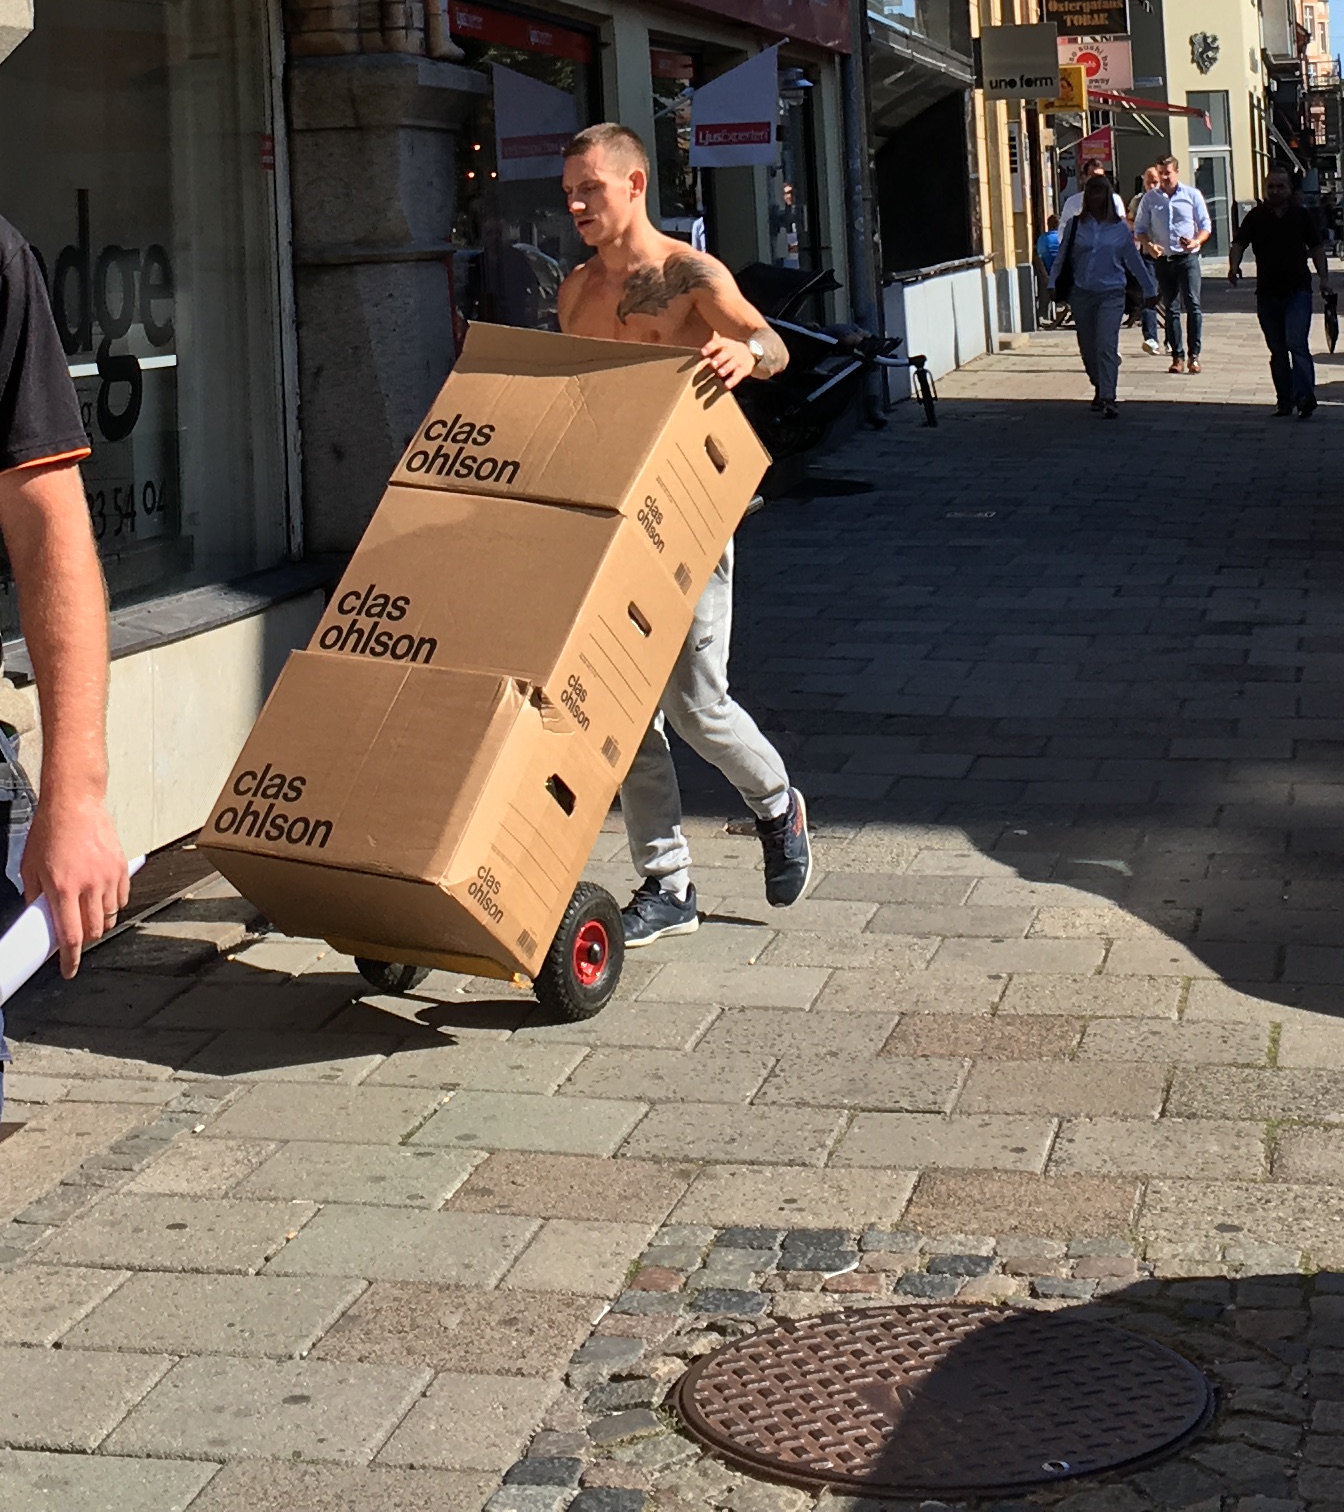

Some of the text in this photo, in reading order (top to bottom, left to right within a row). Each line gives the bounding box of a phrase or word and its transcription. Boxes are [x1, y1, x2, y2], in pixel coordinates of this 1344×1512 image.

[1063, 13, 1109, 27] TOBAK
[989, 74, 1054, 90] uno form
[31, 189, 177, 441] dge
[423, 413, 496, 448] clas
[405, 446, 522, 485] ohlson
[644, 494, 664, 526] clas
[637, 508, 666, 554] ohlson
[335, 583, 412, 622] clas
[318, 618, 439, 665] ohlson
[567, 674, 588, 703] clas
[560, 689, 591, 732] ohlson
[231, 763, 308, 804] clas
[212, 801, 334, 850] ohlson
[477, 865, 502, 896] clas
[467, 881, 505, 925] ohlson
